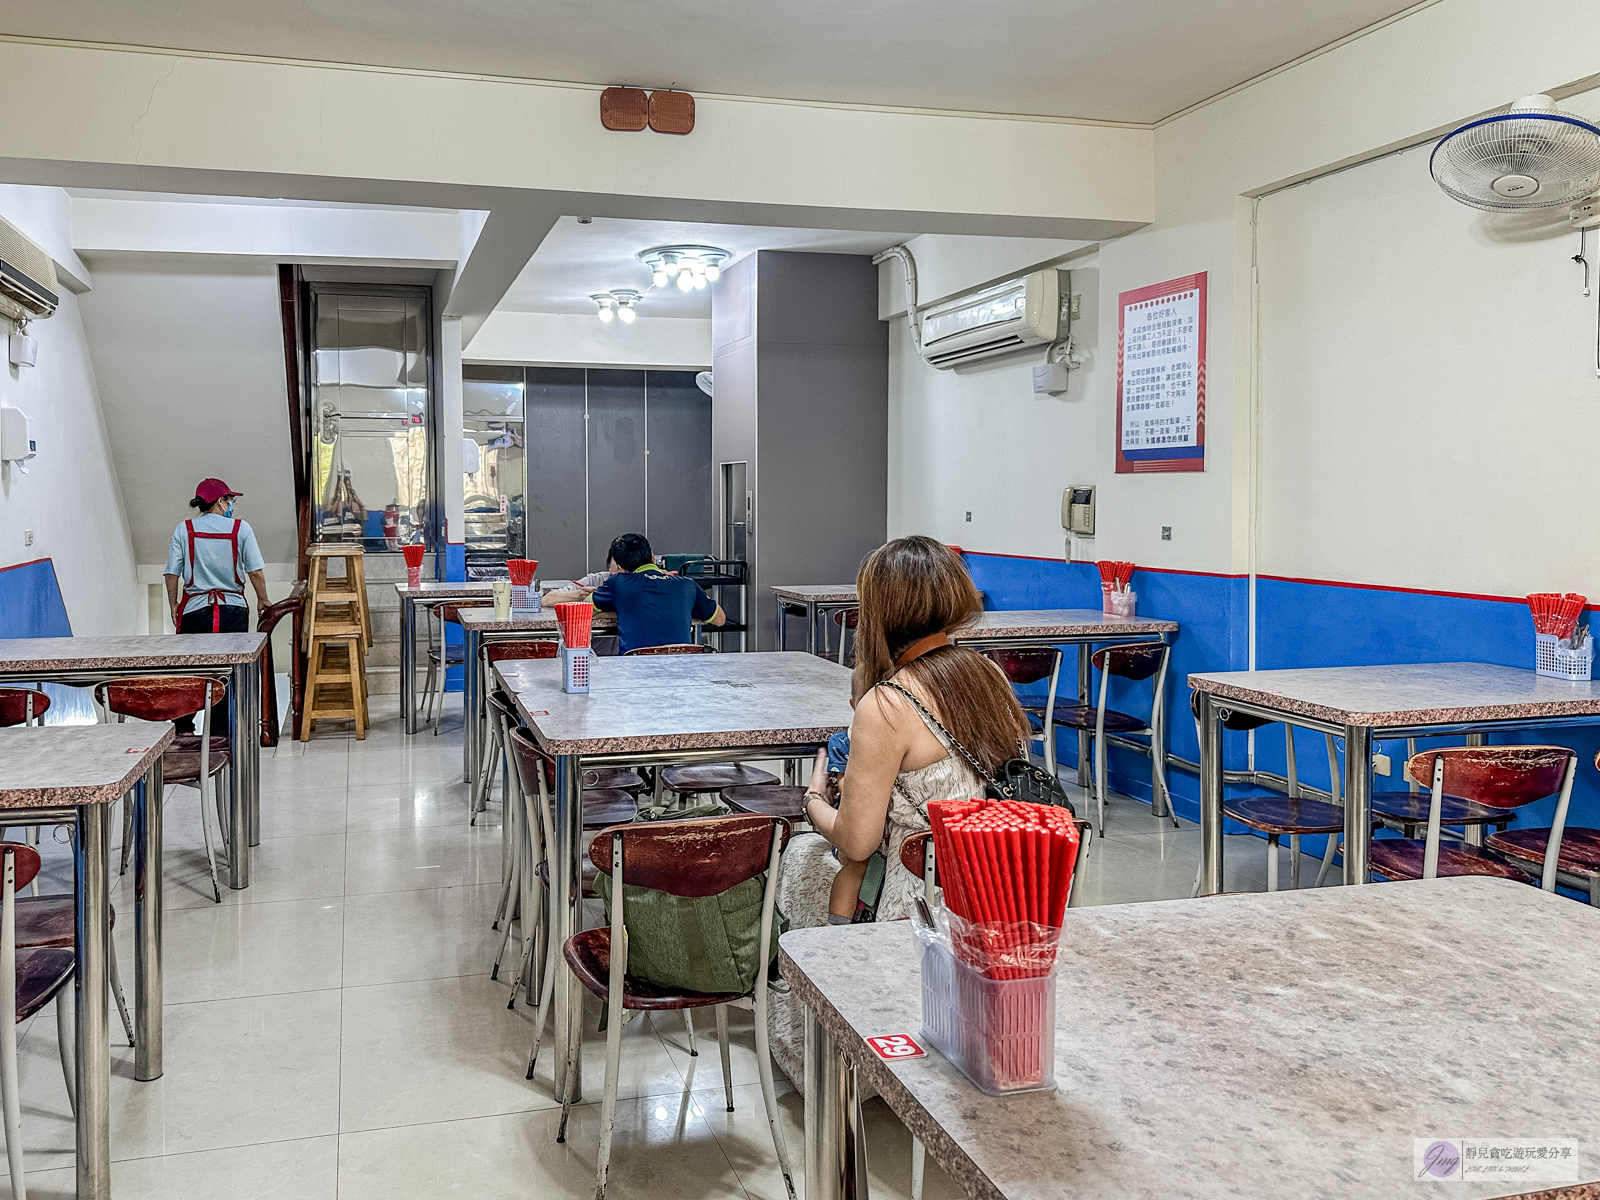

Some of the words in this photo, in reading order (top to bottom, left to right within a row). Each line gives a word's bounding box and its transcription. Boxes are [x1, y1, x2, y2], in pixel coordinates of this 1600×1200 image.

[1147, 307, 1177, 321] 各位好客人
[873, 1036, 916, 1056] 29
